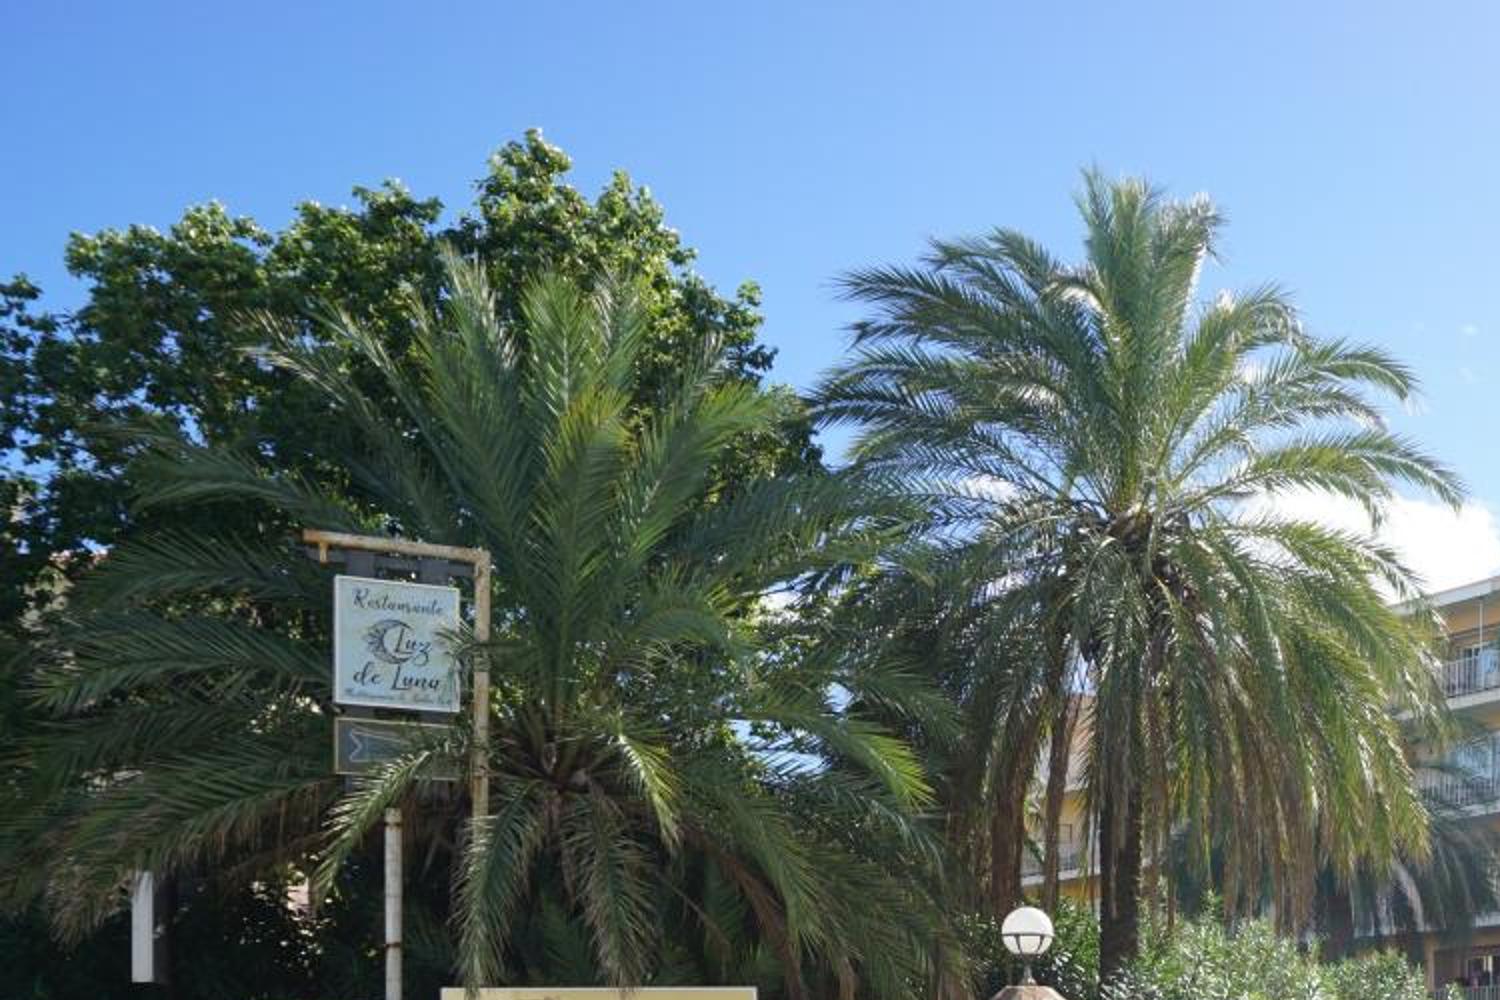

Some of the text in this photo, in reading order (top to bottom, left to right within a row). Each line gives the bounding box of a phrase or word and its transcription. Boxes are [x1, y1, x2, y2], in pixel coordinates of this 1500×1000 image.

[394, 628, 432, 666] Luz
[353, 661, 440, 692] de Luna
